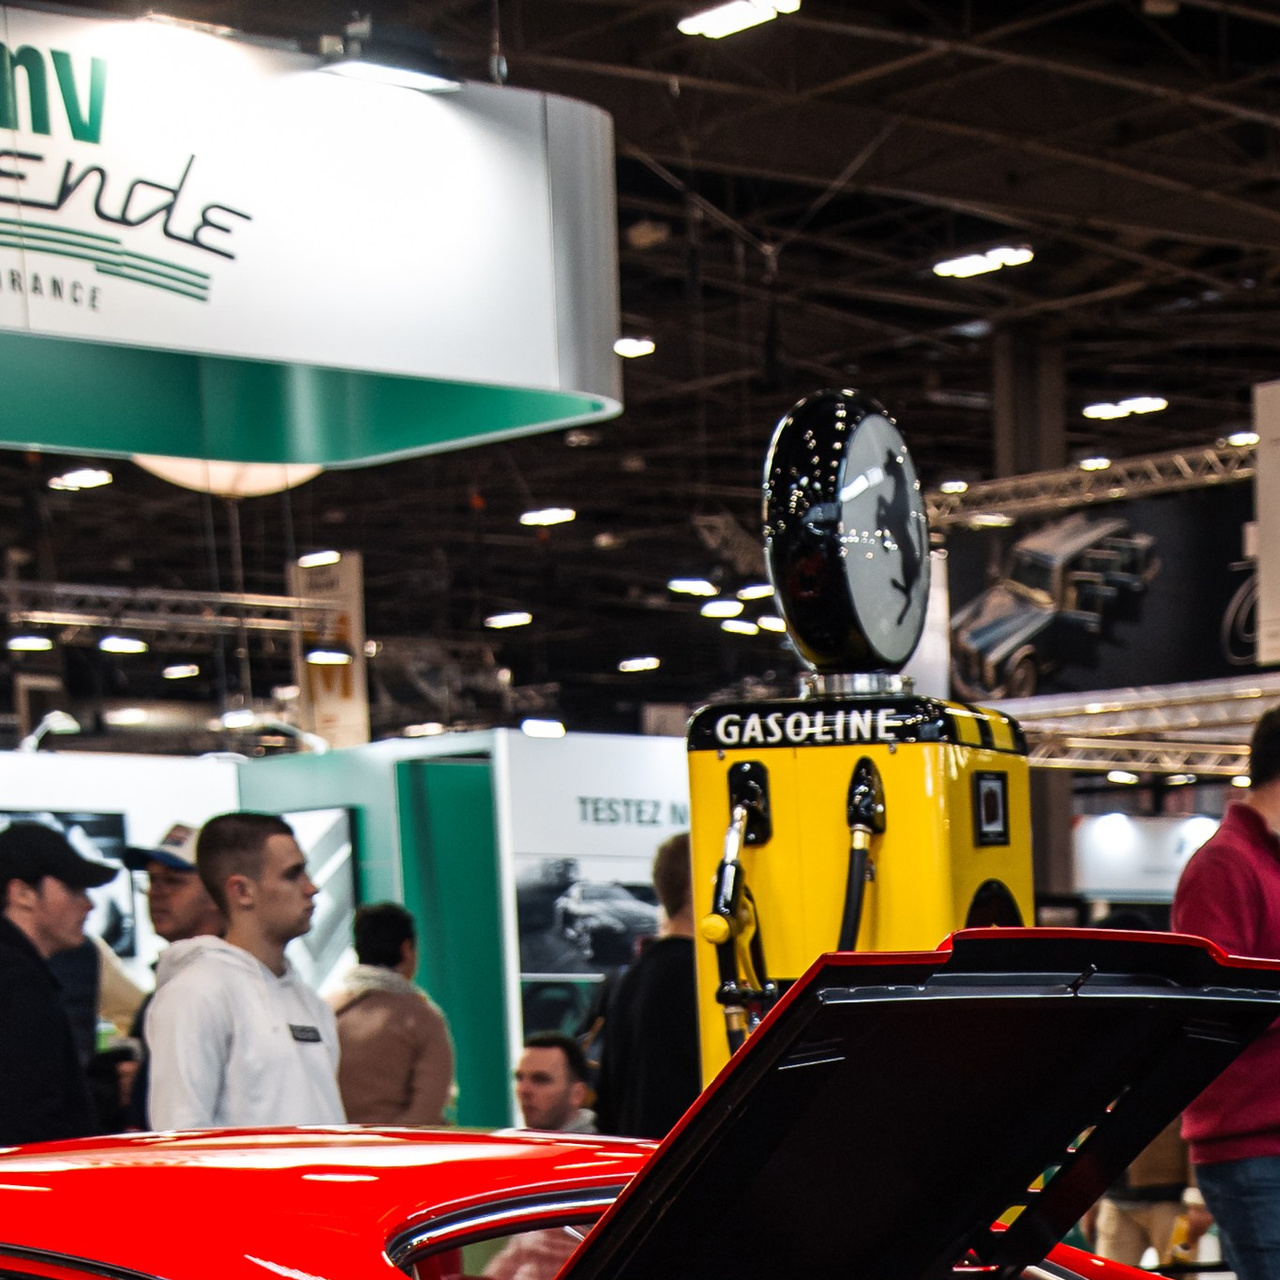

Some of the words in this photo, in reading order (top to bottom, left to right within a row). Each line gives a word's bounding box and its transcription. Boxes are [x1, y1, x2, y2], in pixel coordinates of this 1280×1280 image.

[0, 267, 103, 312] RANCE
[714, 708, 898, 746] GASOLINE
[578, 796, 661, 824] TESTEZ
